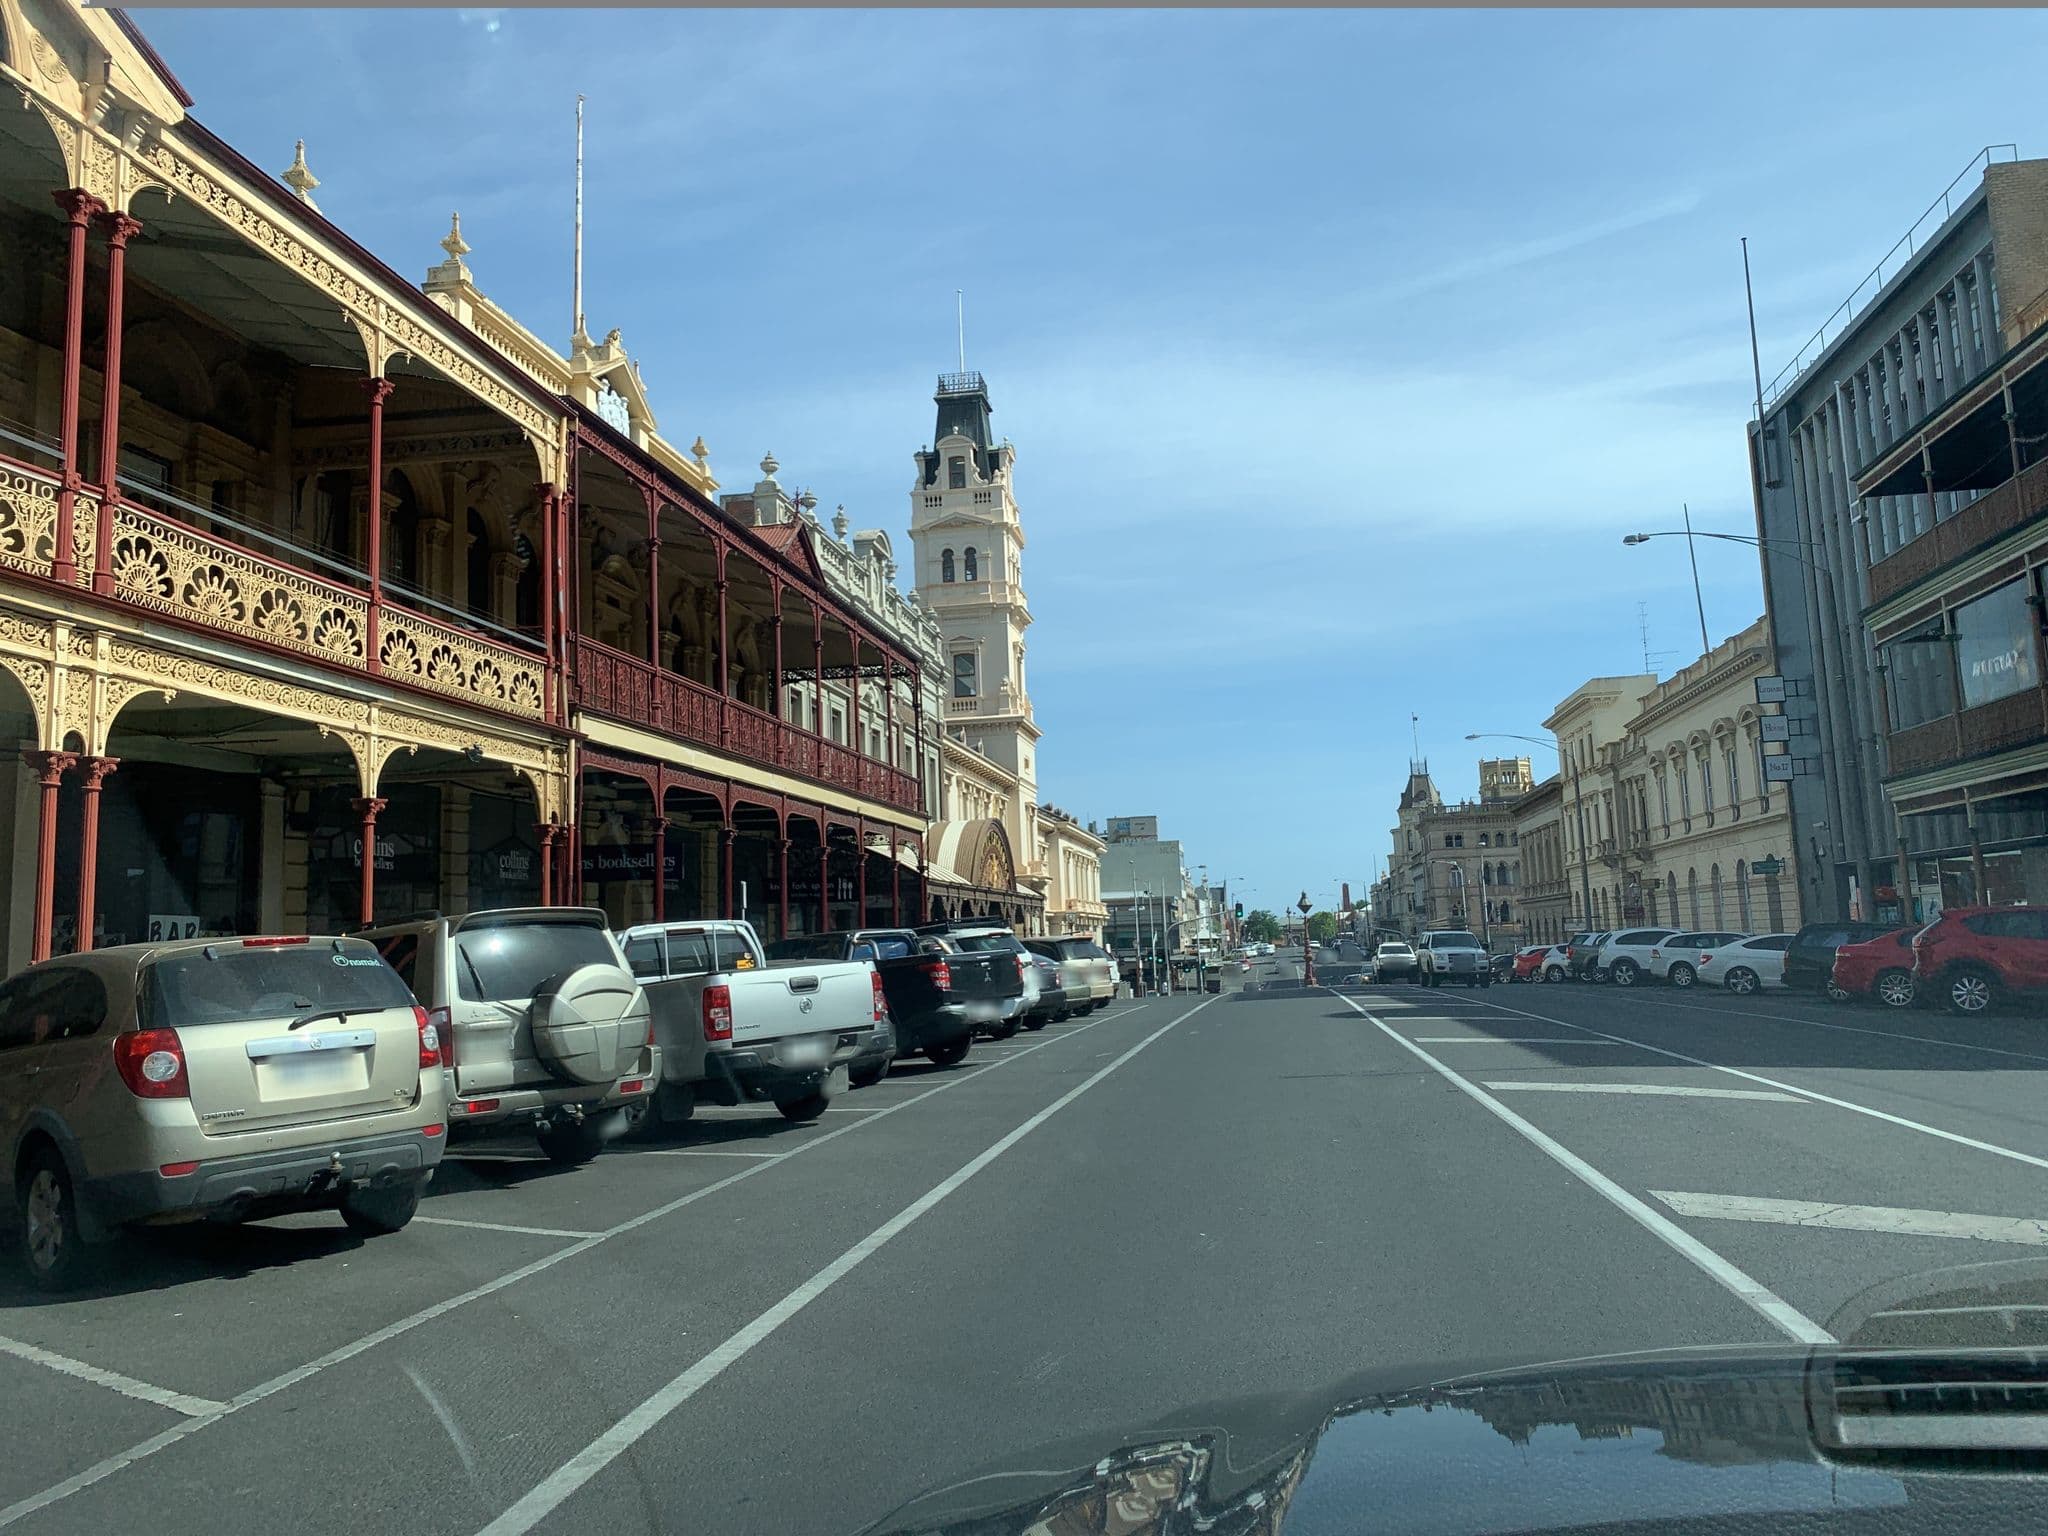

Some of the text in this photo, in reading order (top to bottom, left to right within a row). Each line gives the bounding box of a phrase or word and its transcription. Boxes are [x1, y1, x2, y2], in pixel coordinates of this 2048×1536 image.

[499, 849, 529, 869] collins
[598, 852, 676, 869] booksellrs
[151, 920, 197, 942] BAR
